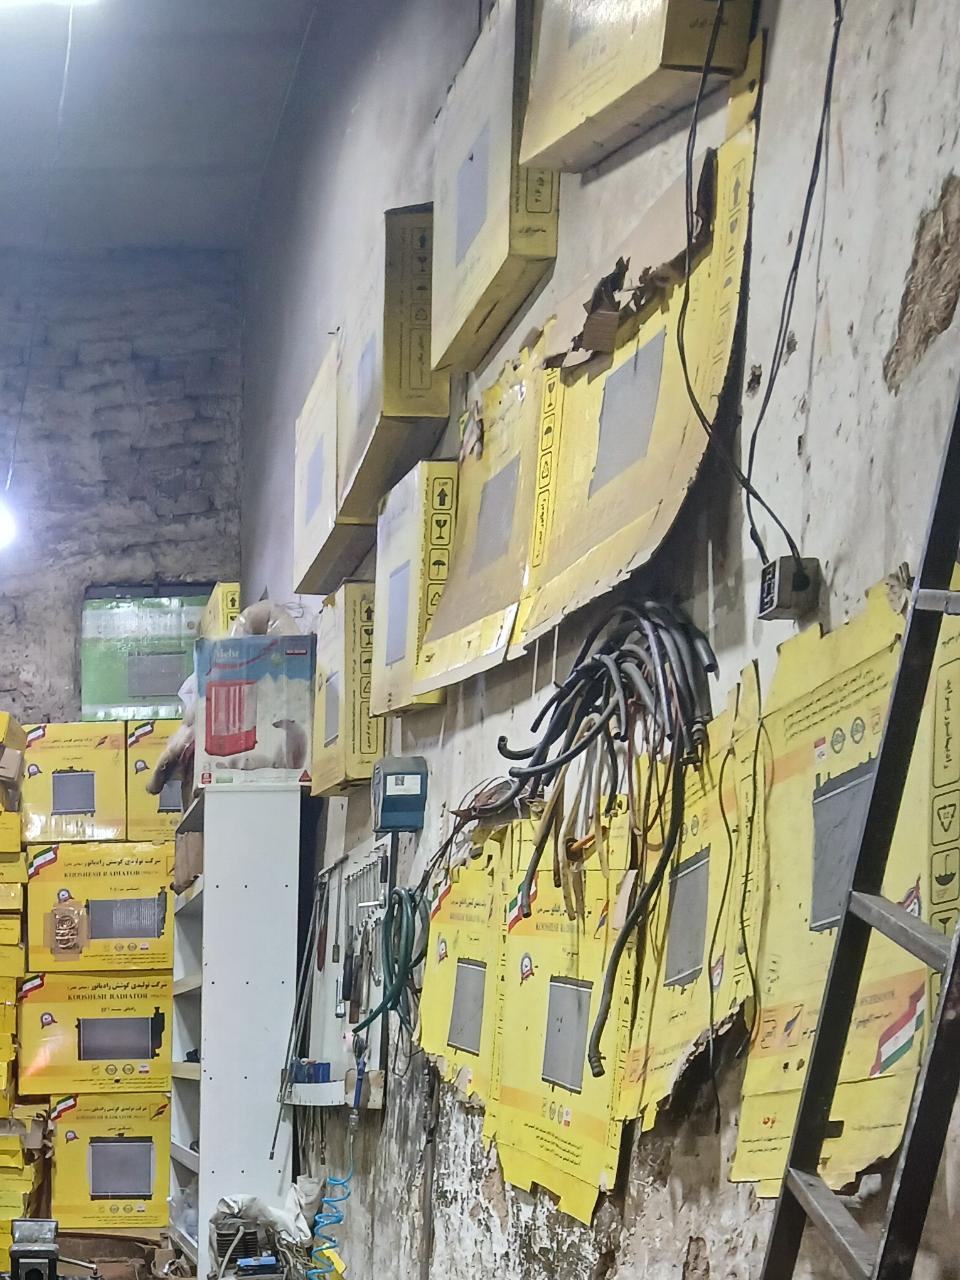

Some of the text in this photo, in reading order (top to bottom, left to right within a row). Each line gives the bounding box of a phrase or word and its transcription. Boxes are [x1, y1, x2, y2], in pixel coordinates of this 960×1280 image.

[91, 982, 111, 991] رادیاتور
[111, 982, 130, 990] کوشش
[130, 981, 150, 990] تولیدی
[151, 980, 168, 989] شرکت
